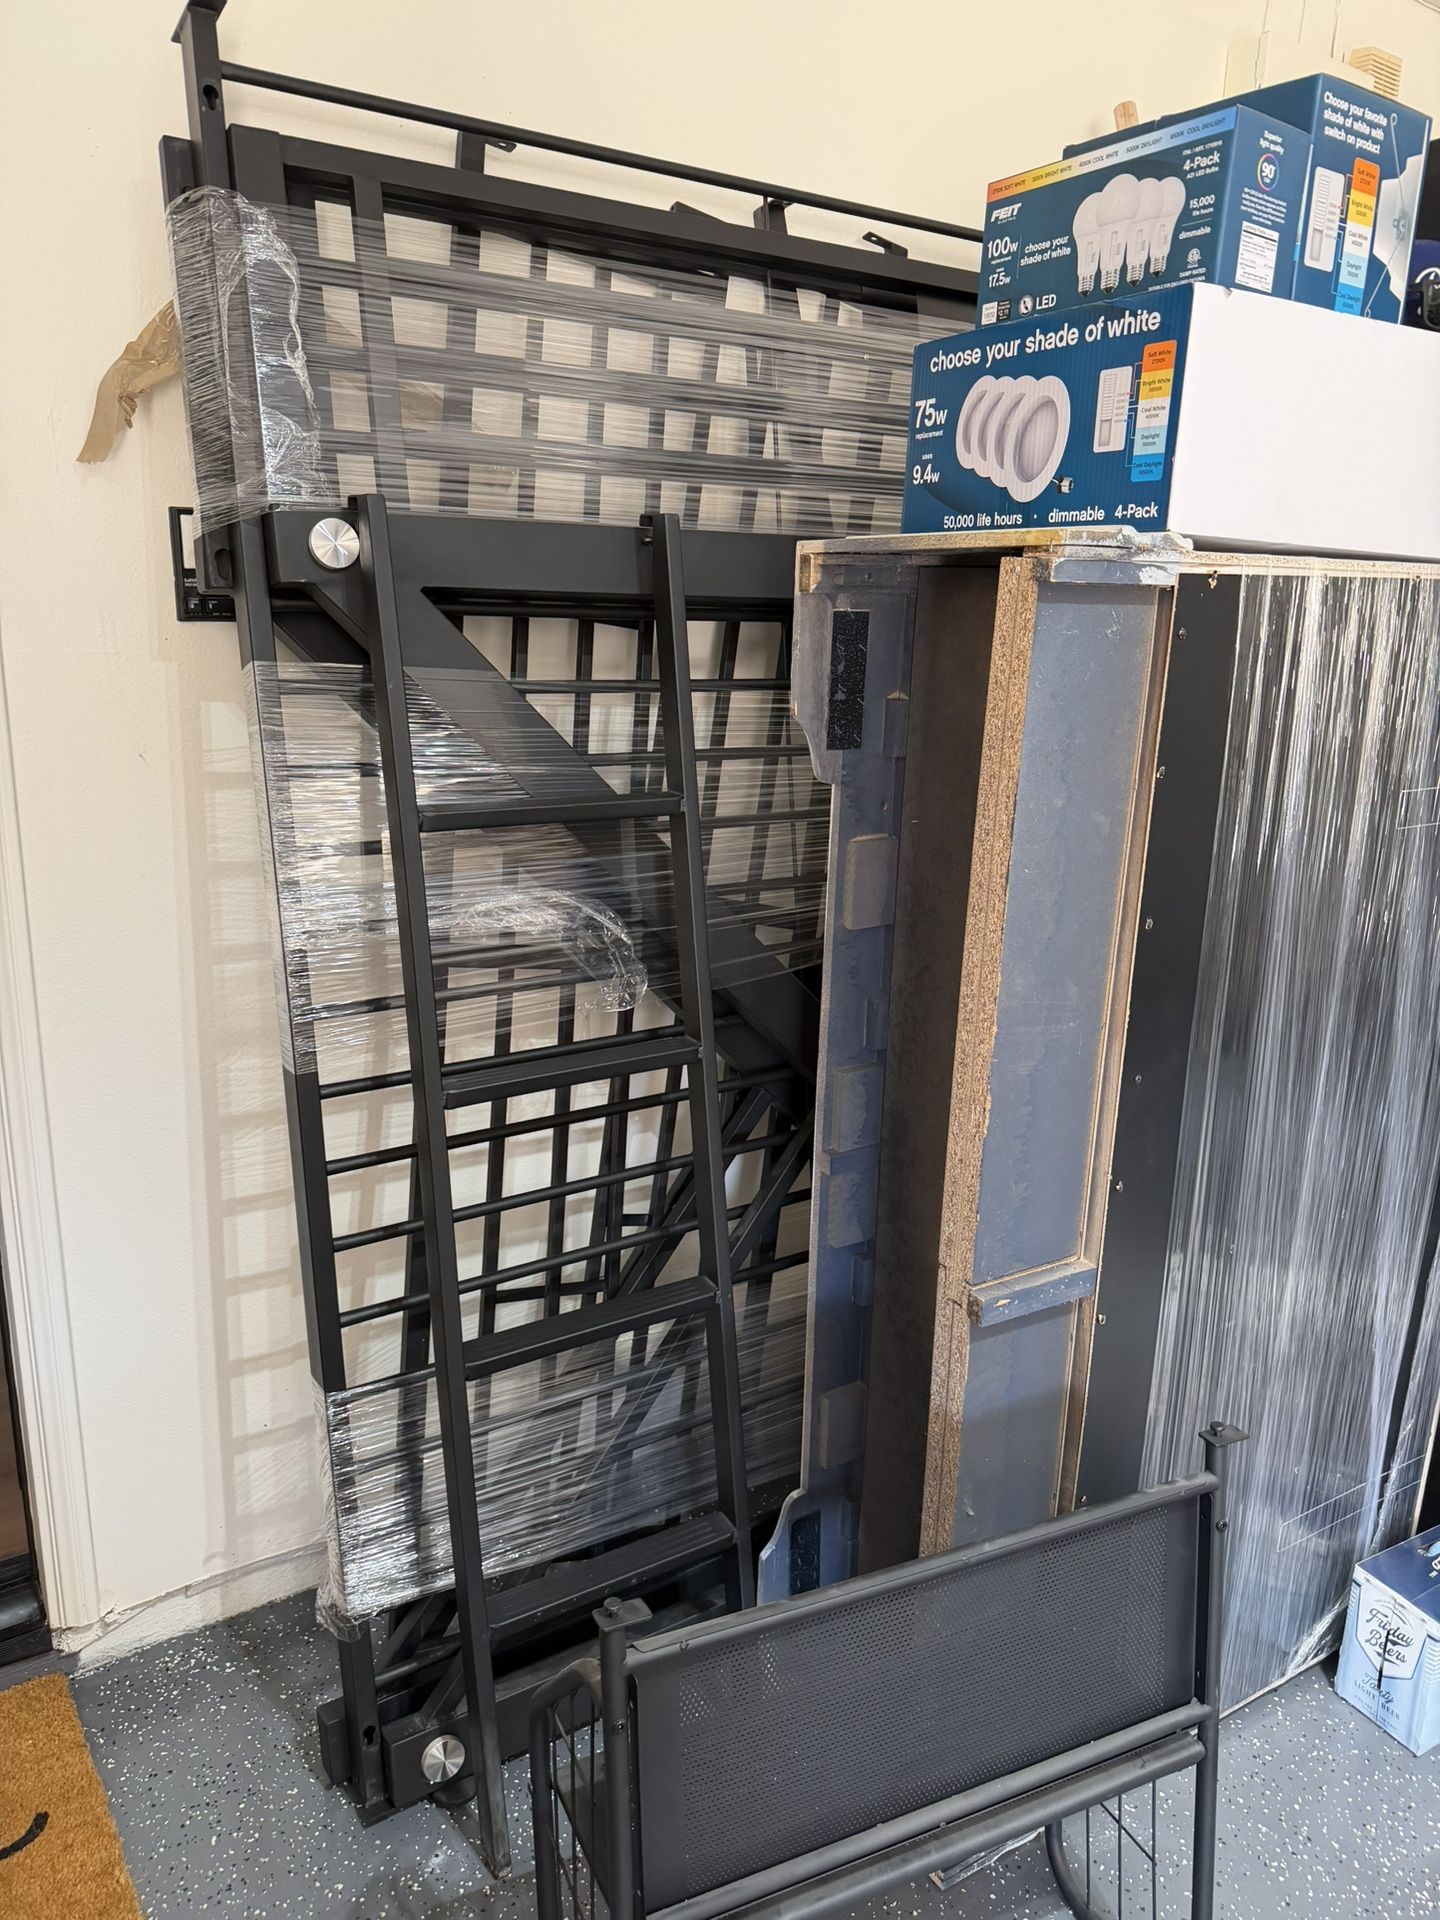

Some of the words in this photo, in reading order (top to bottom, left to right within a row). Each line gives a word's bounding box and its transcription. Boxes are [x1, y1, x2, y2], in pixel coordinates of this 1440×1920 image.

[1324, 91, 1348, 110] Choose
[1349, 104, 1364, 117] your
[1364, 108, 1388, 126] favorite
[1324, 108, 1344, 124] shade
[1344, 117, 1353, 127] of
[1353, 120, 1370, 134] white
[1371, 128, 1384, 140] with
[1324, 126, 1346, 140] switch
[1346, 134, 1356, 144] on
[1356, 138, 1380, 154] product
[1183, 150, 1220, 171] 4-Pack
[1190, 194, 1216, 208] 15,000
[991, 203, 1022, 222] FEIT
[1179, 226, 1212, 240] dimmable
[1025, 240, 1050, 254] choose
[1052, 235, 1070, 250] your
[1020, 251, 1041, 266] shade
[1043, 249, 1050, 260] of
[1051, 246, 1072, 258] white
[1036, 294, 1056, 310] LED
[930, 347, 982, 372] choose
[986, 338, 1020, 368] your
[1025, 322, 1079, 354] shade
[1084, 316, 1104, 342] of
[1108, 309, 1160, 338] white
[915, 430, 944, 440] replacement
[944, 514, 974, 530] 50,000
[976, 512, 992, 528] life
[994, 512, 1022, 526] hours
[1048, 506, 1105, 523] dimmable
[1114, 502, 1158, 519] 4-Pack
[1366, 1607, 1414, 1647] Friday
[1365, 1629, 1407, 1663] Beers
[1354, 1680, 1376, 1701] LIGHT
